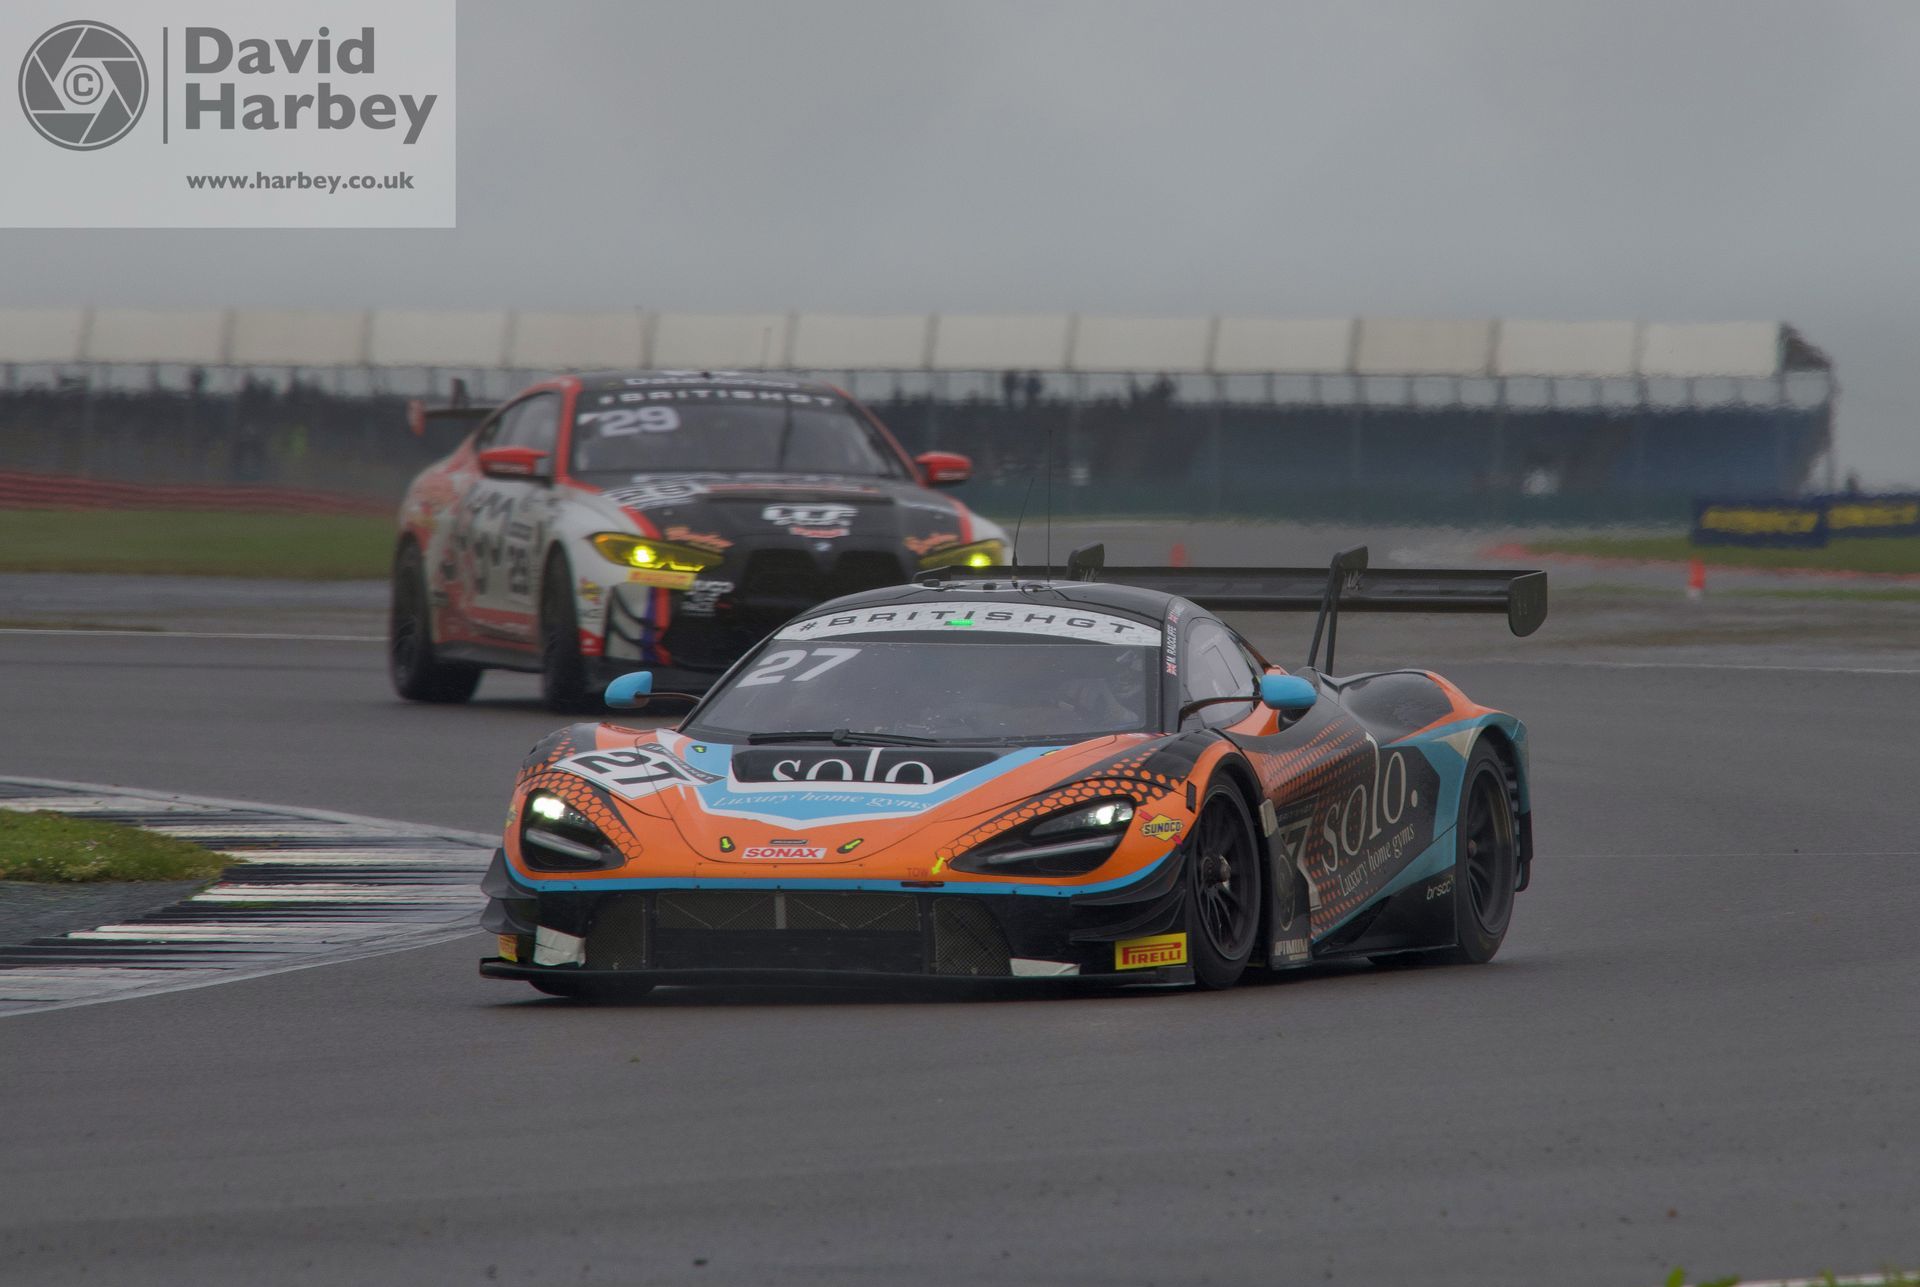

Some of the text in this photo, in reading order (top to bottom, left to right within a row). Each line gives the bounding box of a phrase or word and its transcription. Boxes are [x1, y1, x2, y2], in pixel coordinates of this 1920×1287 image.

[601, 406, 680, 437] 29
[799, 610, 1135, 634] #BRITISHGT
[736, 647, 863, 689] 27
[571, 751, 692, 785] 27
[713, 791, 933, 809] Luxury home gyms
[1144, 821, 1180, 835] SUNOCO
[745, 848, 819, 858] SONAX
[1339, 824, 1416, 897] Luxury home gyms
[907, 867, 929, 878] TOW
[1122, 942, 1182, 965] PIRELLI
